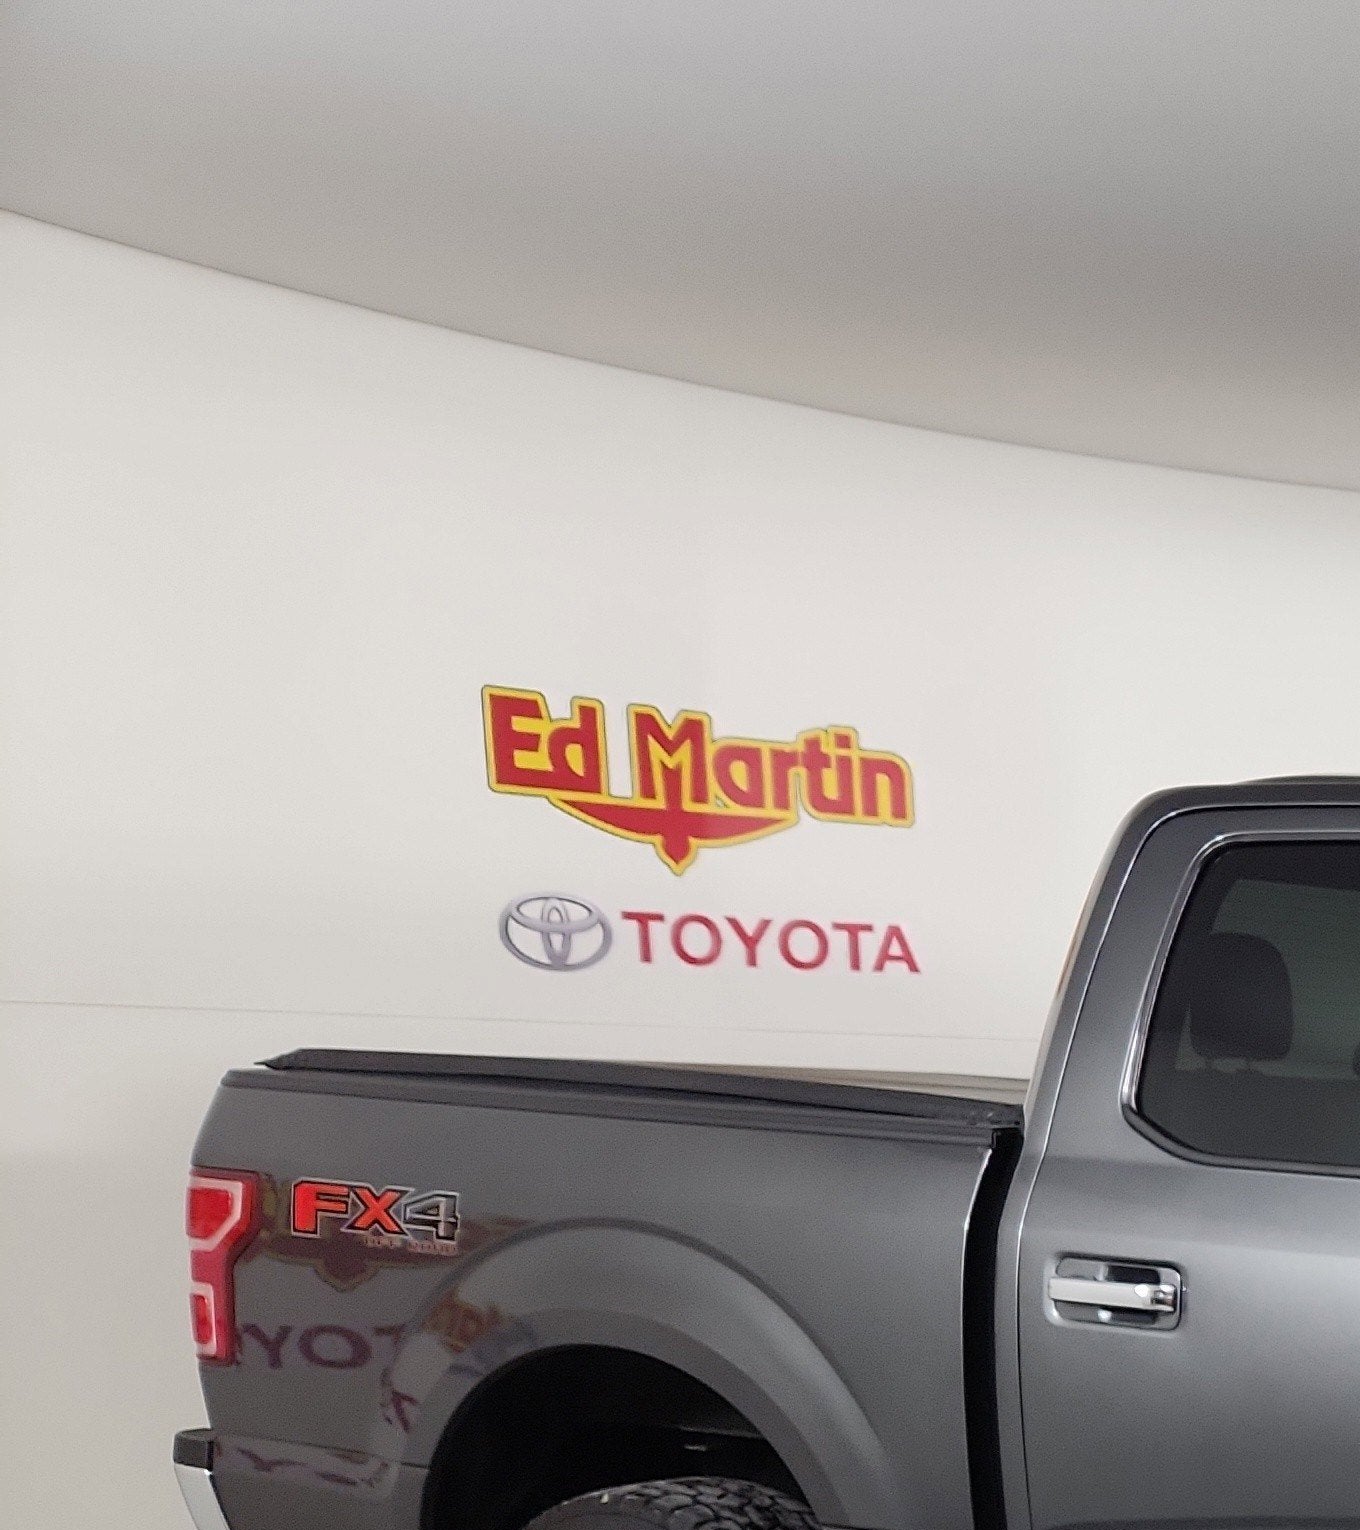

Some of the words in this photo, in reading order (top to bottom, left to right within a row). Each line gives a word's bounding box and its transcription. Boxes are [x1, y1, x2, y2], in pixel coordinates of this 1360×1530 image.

[487, 690, 604, 796] Ed
[632, 708, 910, 823] Martin
[619, 908, 922, 975] TOYOTA
[290, 1176, 461, 1245] FX4
